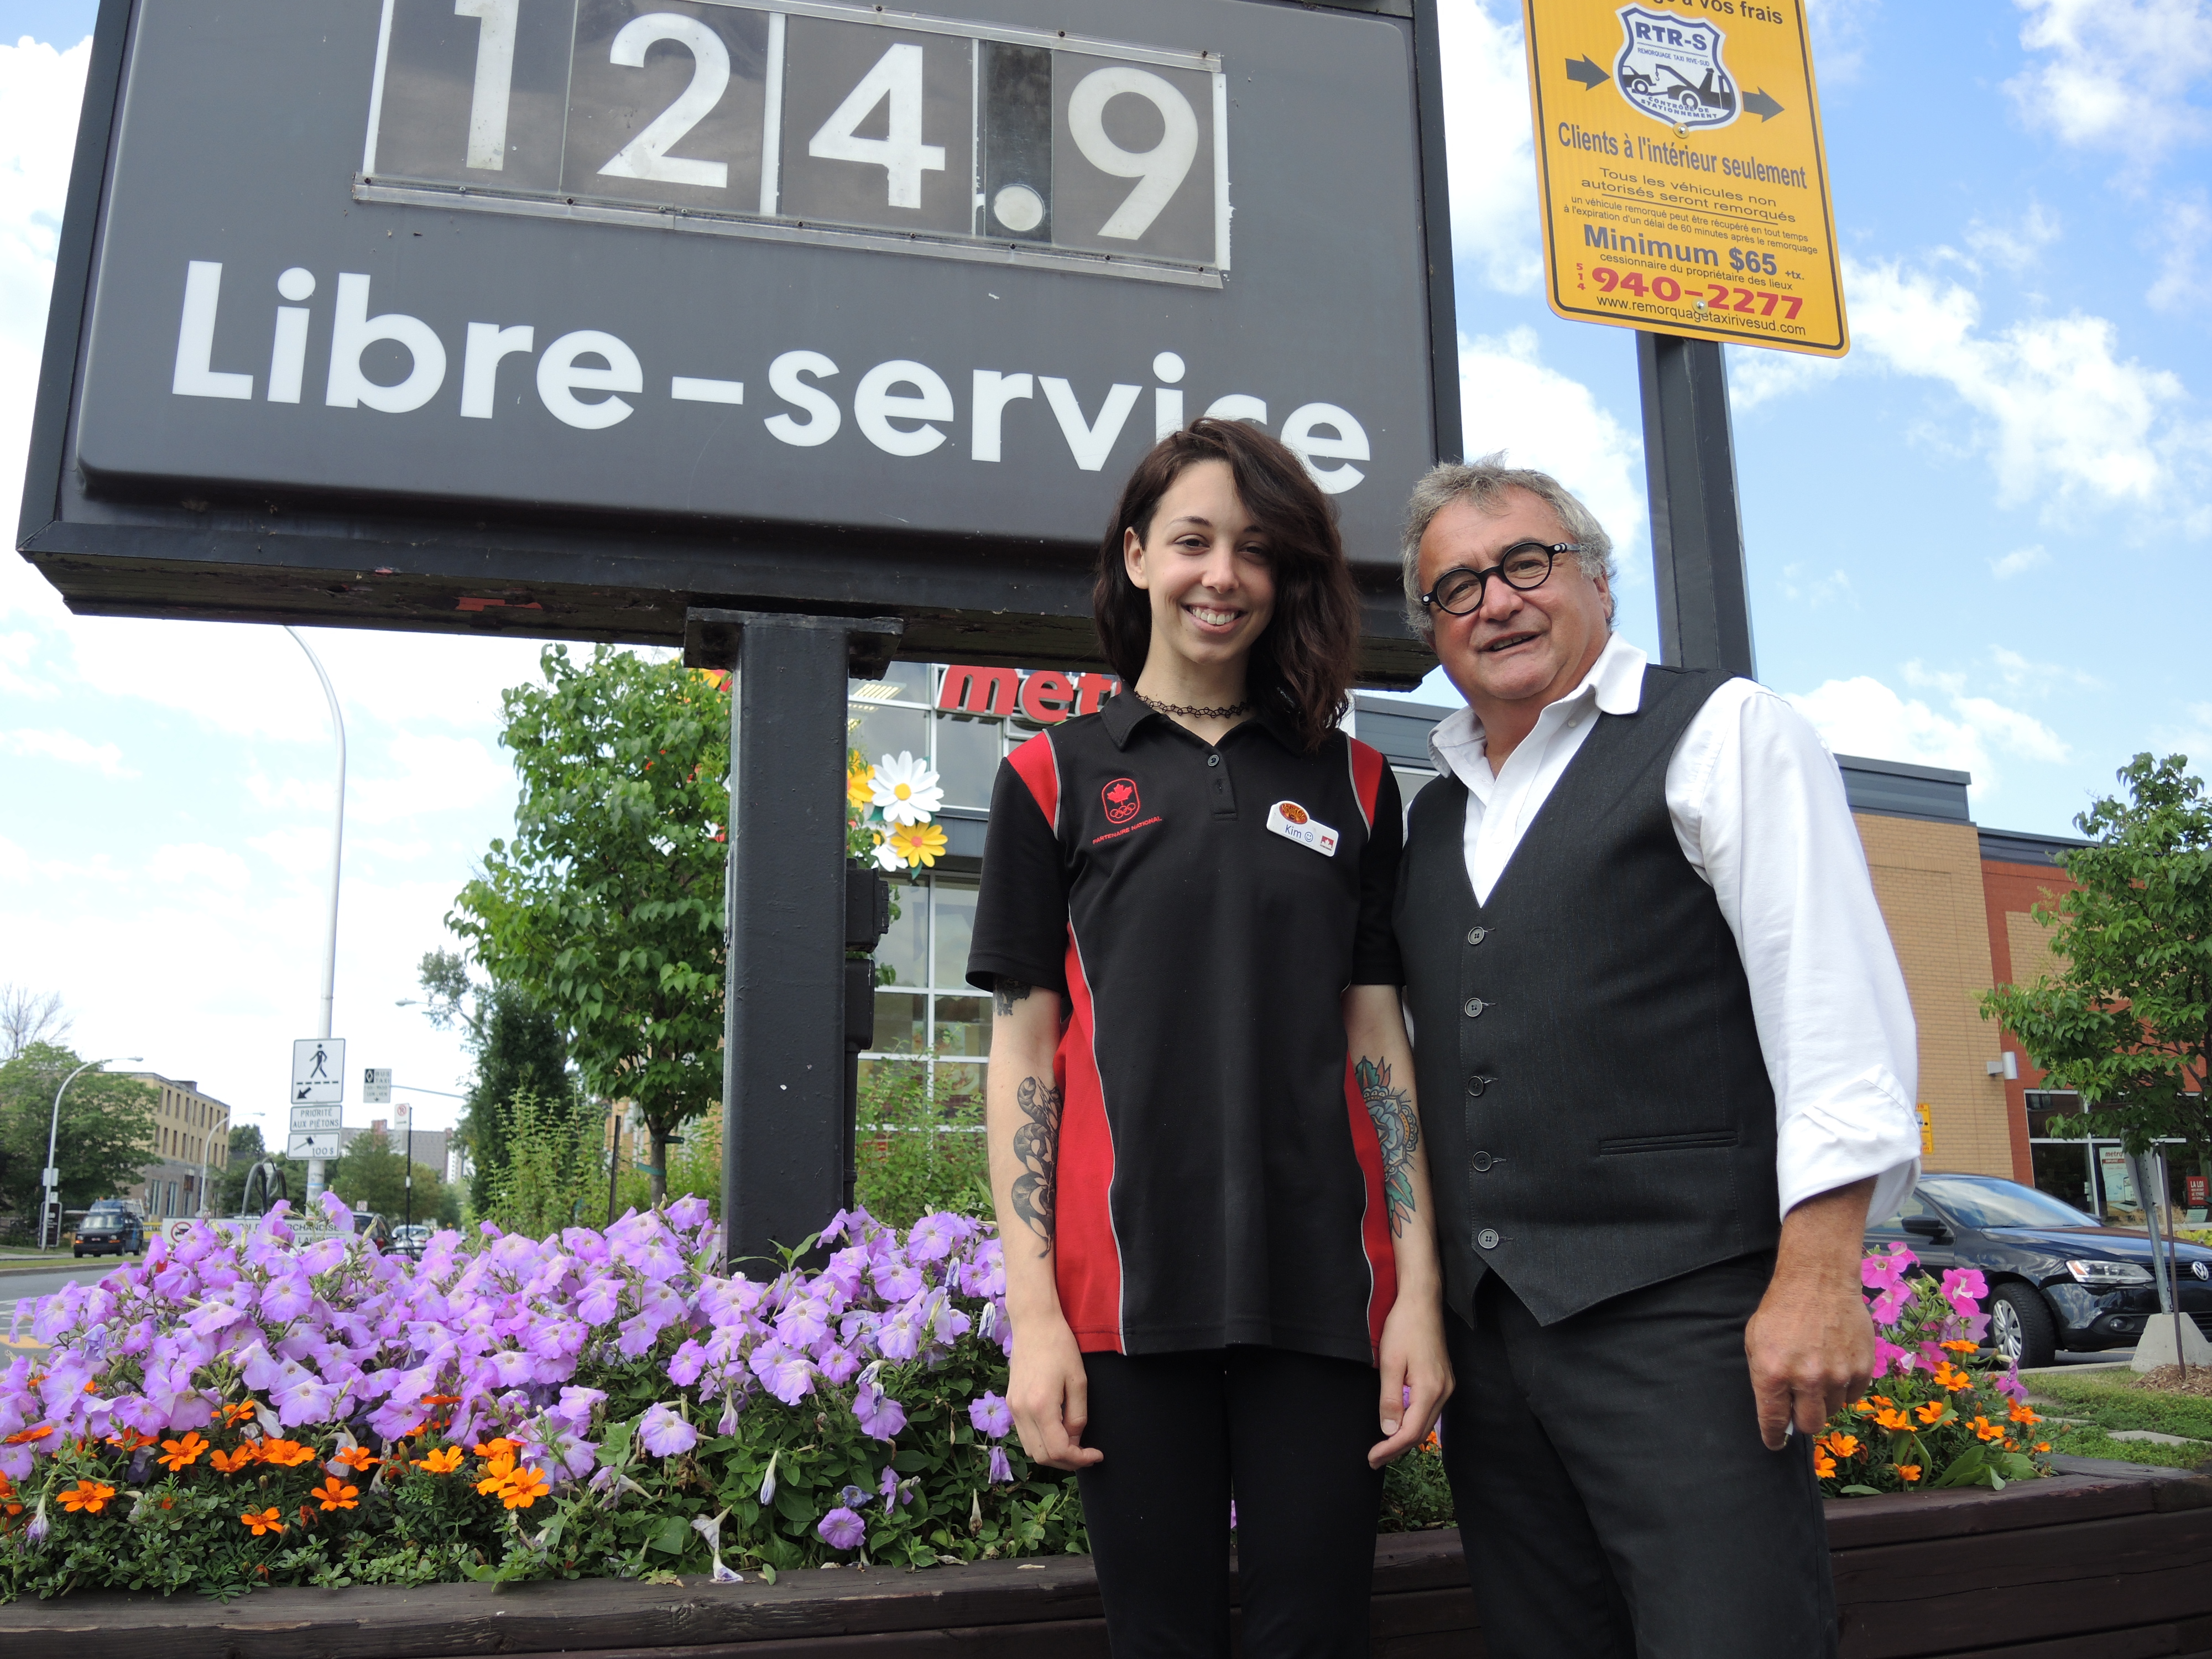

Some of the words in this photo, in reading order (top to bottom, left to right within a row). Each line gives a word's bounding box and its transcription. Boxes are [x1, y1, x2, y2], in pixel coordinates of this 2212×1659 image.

[1700, 0, 1734, 14] vos
[1740, 1, 1783, 24] frais
[1635, 21, 1707, 51] RTR-S
[1637, 48, 1671, 60] REMORQUAGE
[1673, 54, 1684, 62] TAXI
[1686, 57, 1710, 66] RIVE-SUD
[1641, 99, 1717, 118] STATIONNEMENT
[1648, 96, 1694, 112] CONTRÔLE
[1558, 122, 1619, 156] Clients
[1624, 133, 1634, 158] à
[1638, 136, 1717, 173] l'intérieur
[1722, 156, 1807, 189] seulement
[1582, 179, 1654, 198] autorisés
[1660, 193, 1709, 208] seront
[1714, 201, 1796, 222] remorqués
[1599, 167, 1637, 182] Tous
[1643, 175, 1665, 187] les
[1671, 181, 1743, 201] véhicules
[1749, 195, 1776, 207] non
[1564, 205, 1569, 213] à
[1572, 206, 1620, 221] l'expiration
[1623, 215, 1641, 225] d'un
[1644, 218, 1665, 228] délai
[1681, 224, 1692, 233] 60
[1694, 227, 1728, 239] minutes
[1731, 234, 1755, 243] après
[1757, 237, 1765, 245] le
[1767, 240, 1818, 254] remorquage
[1585, 198, 1622, 210] véhicule
[1625, 205, 1667, 217] remorqué
[1670, 212, 1689, 222] peut
[1692, 215, 1709, 225] être
[1711, 219, 1749, 232] récupéré
[1764, 227, 1780, 237] tout
[1782, 231, 1808, 242] temps
[1584, 223, 1719, 267] Minimum
[1729, 247, 1777, 275] $65
[1785, 270, 1804, 280] +tx.
[1600, 254, 1667, 270] cessionnaire
[1670, 263, 1683, 273] du
[1687, 268, 1744, 283] propriétaire
[1747, 276, 1766, 286] des
[1770, 279, 1793, 290] lieux
[1592, 267, 1803, 320] 940-2277
[1597, 296, 1806, 336] www.remorquagetaxirivesud.com
[936, 665, 1121, 723] met
[1092, 827, 1130, 845] PARTENAIRE
[1131, 816, 1162, 831] NATIONAL
[1285, 824, 1301, 839] Kim
[300, 1108, 332, 1117] PRIORITÉ
[310, 1119, 339, 1128] PIÉTONS
[287, 1223, 340, 1232] RCHANDISE
